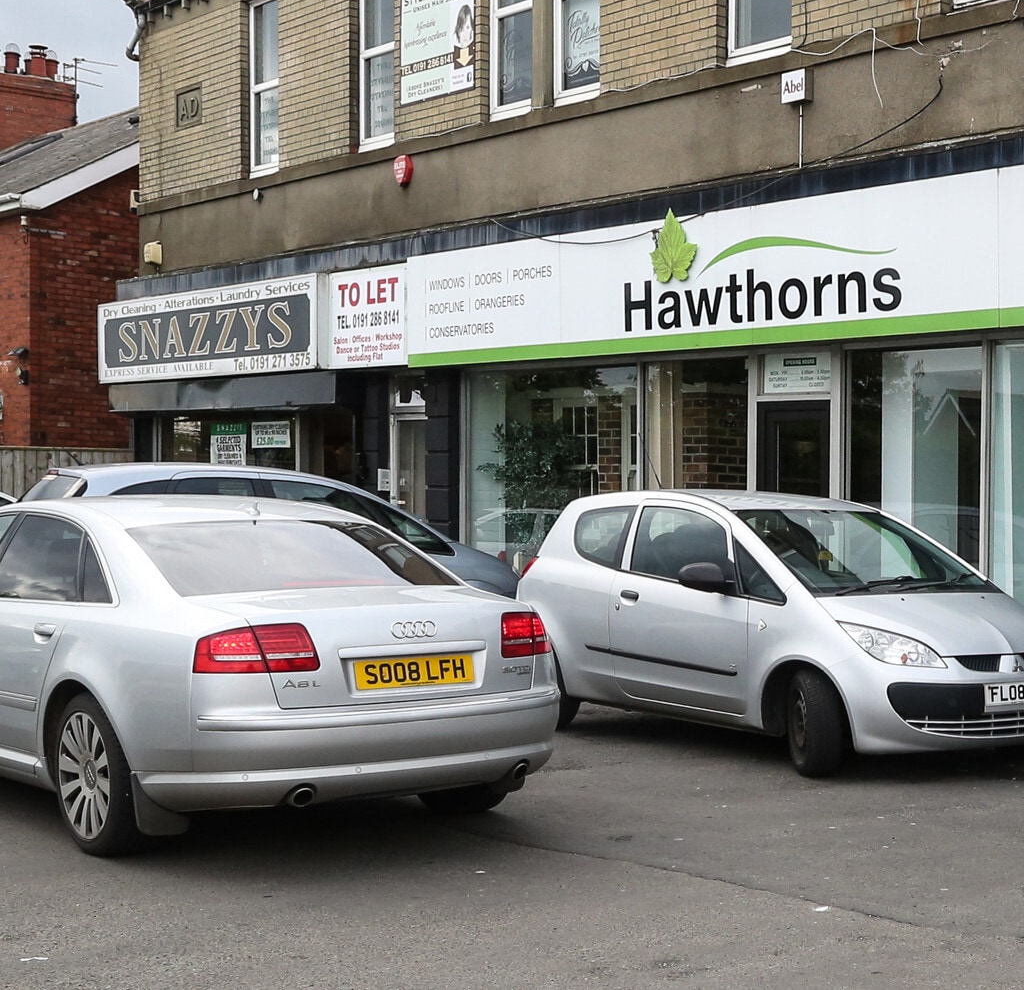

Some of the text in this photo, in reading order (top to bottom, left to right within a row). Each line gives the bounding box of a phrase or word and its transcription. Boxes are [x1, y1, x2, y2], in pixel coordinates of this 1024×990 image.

[413, 62, 426, 72] 0191
[427, 57, 440, 68] 286
[440, 53, 454, 65] 8141
[783, 77, 803, 95] Abel
[429, 265, 552, 291] WINDOWS DOORS PORCHES
[103, 281, 310, 318] Dry Cleaning Alterations Laundry Services
[338, 277, 399, 308] TO LET
[623, 267, 902, 332] Hawthorns
[429, 293, 525, 315] ROOFLINE ORANGERIES
[337, 309, 399, 330] TEL. 0191 286 8141
[118, 301, 291, 363] SNAZZYS
[429, 322, 494, 339] CONSERVATORIES
[104, 361, 214, 378] EXPRESS SERVICE AVAILABLE
[234, 352, 310, 372] Tel. 0191 271 3575
[364, 658, 466, 685] SO08 LFH
[990, 684, 1024, 702] FL08
